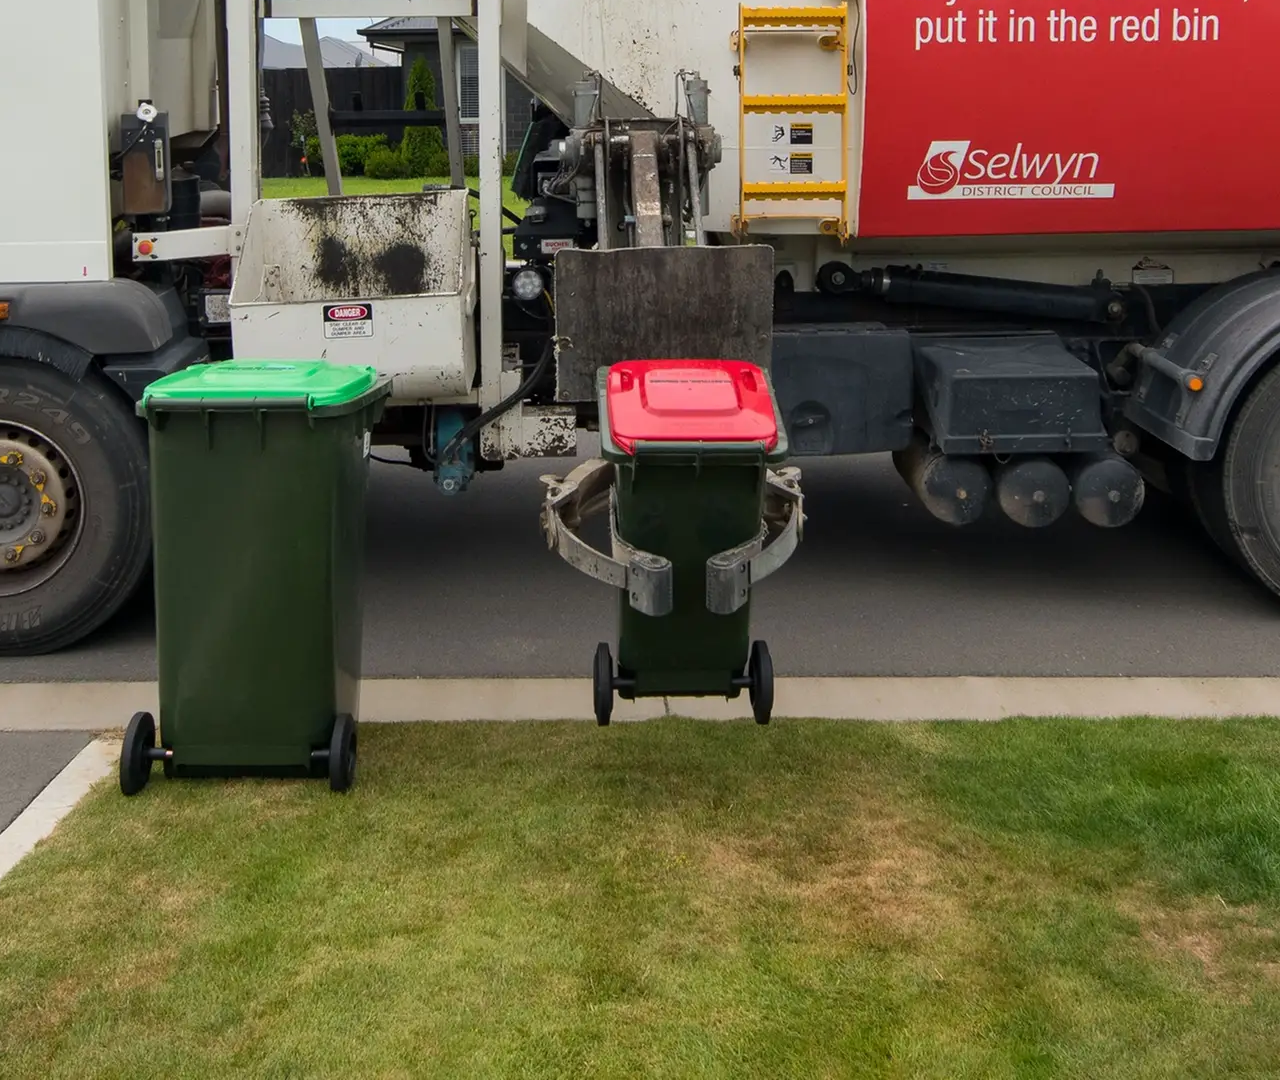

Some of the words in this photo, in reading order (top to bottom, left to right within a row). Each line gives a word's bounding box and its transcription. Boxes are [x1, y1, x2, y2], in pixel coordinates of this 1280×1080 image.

[915, 10, 967, 51] put
[978, 9, 998, 43] it
[1009, 9, 1035, 43] in
[1046, 8, 1097, 43] the
[1110, 8, 1160, 42] red
[1172, 7, 1219, 42] bin
[963, 142, 1100, 185] Selwyn
[961, 185, 1027, 197] DISTRICT
[1031, 184, 1095, 196] COUNCIL
[334, 308, 361, 318] DANGER
